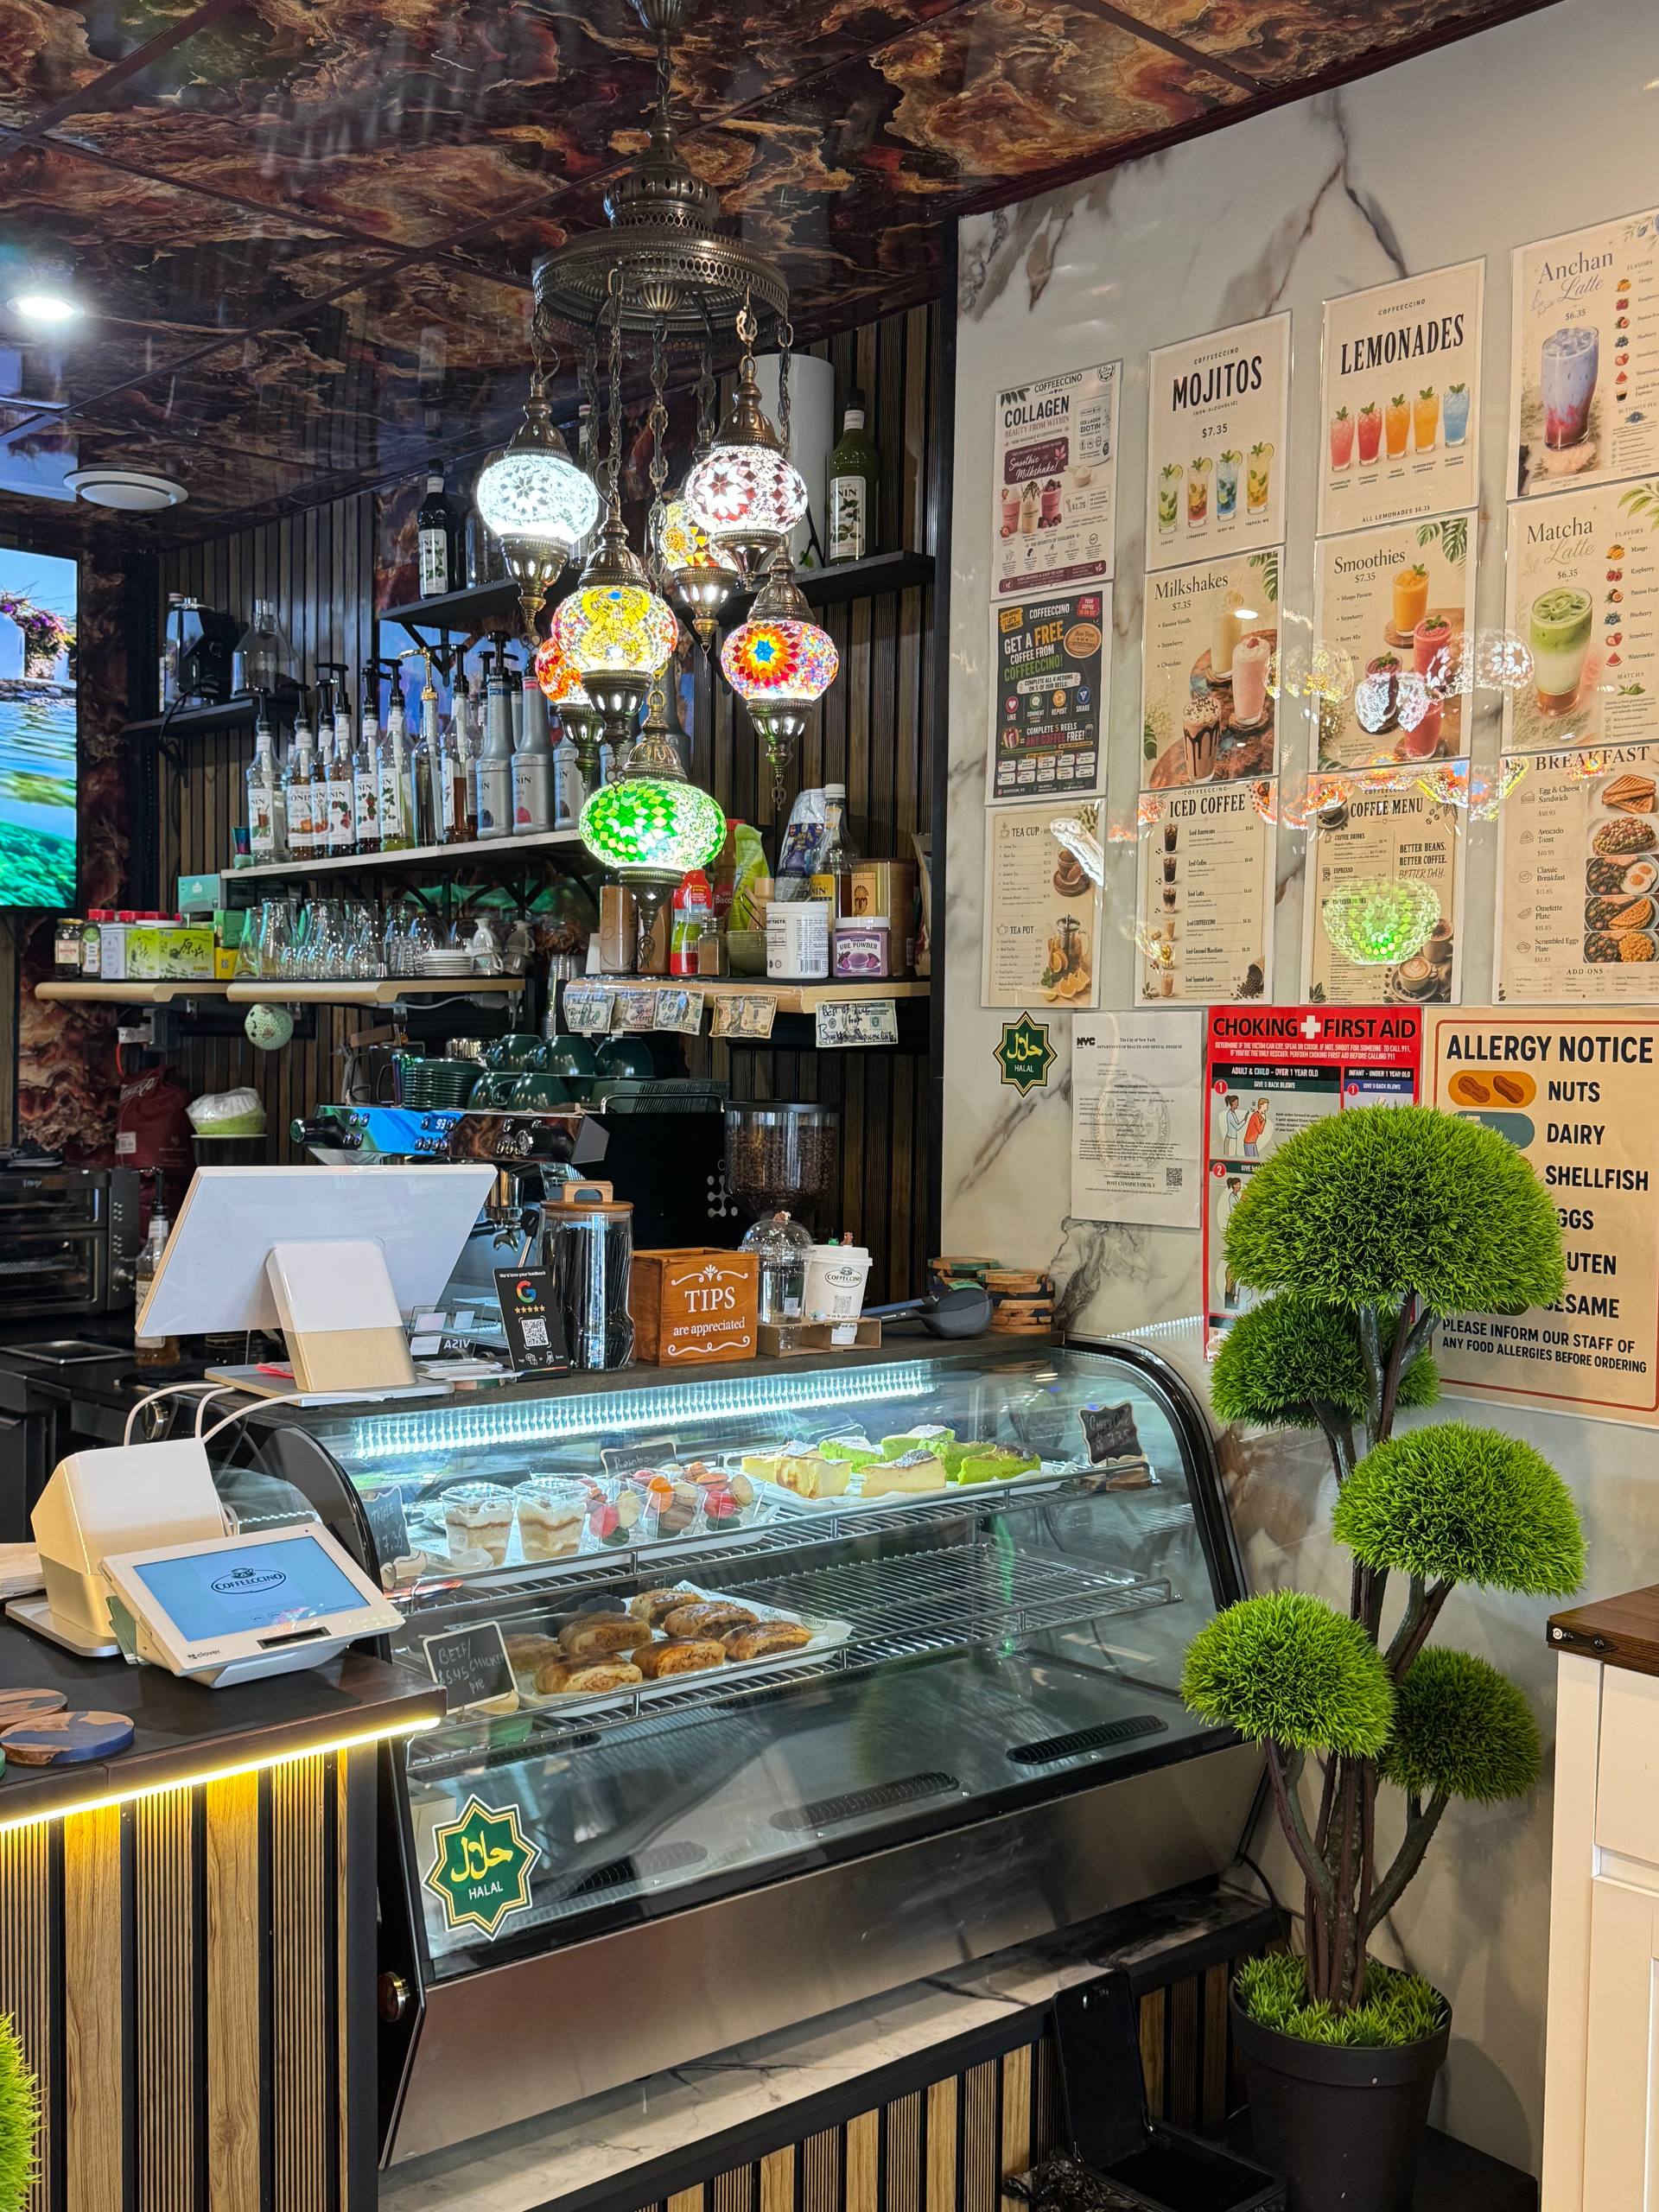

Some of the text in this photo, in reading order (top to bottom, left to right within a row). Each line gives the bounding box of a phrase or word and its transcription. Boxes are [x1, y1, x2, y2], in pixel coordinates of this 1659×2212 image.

[1538, 251, 1612, 285] Anchan
[1557, 274, 1604, 302] Latte
[1378, 298, 1426, 316] COFFEECCINO
[1565, 309, 1586, 321] $6.35
[1340, 313, 1465, 375] LEMONADES
[1193, 346, 1239, 365] COFFEECCINO
[1034, 372, 1083, 393] COFFEECCINO
[1173, 355, 1262, 411] MOJITOS
[1005, 395, 1070, 429] COLLAGEN
[1080, 423, 1101, 433] BIOTIN
[1202, 423, 1228, 439] $7.35
[1008, 454, 1040, 472] Smoothie
[1016, 462, 1058, 481] Milkshake!
[1362, 507, 1413, 523] ALL LEMONADES
[1527, 517, 1593, 544] Matcha
[1543, 537, 1595, 565] Latte
[1334, 549, 1406, 575] Smoothies
[1630, 566, 1655, 575] Raspberry
[1355, 572, 1376, 583] $7.35
[1557, 569, 1578, 580] $6.35
[1154, 572, 1229, 601] Milkshakes
[1029, 603, 1070, 620] COFFEECCINO
[1172, 601, 1192, 611] $7.35
[1630, 610, 1652, 619] Blueberry
[1004, 620, 1064, 655] GET A FREE
[1629, 631, 1653, 639] Strawberry
[1010, 644, 1054, 665] COFFEE FROM
[1004, 653, 1063, 682] COFFEECCINO!
[1618, 671, 1644, 680] MATCHA
[1007, 713, 1017, 721] LIKE
[1052, 707, 1067, 715] REPOST
[1076, 704, 1090, 713] SHARE
[1027, 722, 1077, 735] COMPLETE REELS
[1066, 730, 1084, 741] FREE!
[1535, 746, 1650, 771] BREAKFAST
[1184, 785, 1227, 796] COFFEECCINO
[1538, 795, 1568, 804] Sandwich
[1539, 785, 1581, 796] Egg Cheese
[1170, 794, 1246, 818] ICED COFFEE
[1351, 798, 1423, 817] COFFEE MENU
[1012, 826, 1039, 837] TEA CUP
[1538, 827, 1564, 836] Avocado
[1538, 836, 1554, 844] Toast
[1400, 842, 1446, 854] BETTER BEANS.
[1399, 855, 1447, 867] BETTER COFFEE.
[1399, 868, 1426, 880] BETTER
[1010, 925, 1034, 935] TEA POT
[853, 941, 878, 950] POWDER
[1566, 938, 1579, 946] Eggs
[1212, 1017, 1416, 1039] CHOKING FIRST AID
[1006, 1033, 1044, 1062] حلال
[1076, 1037, 1096, 1046] NYC
[1446, 1034, 1654, 1064] ALLERGY NOTICE
[1014, 1064, 1034, 1073] HALAL
[1275, 1068, 1288, 1077] OVER
[1308, 1069, 1319, 1077] OLD
[1548, 1081, 1600, 1103] NUTS
[1547, 1122, 1605, 1146] DAIRY
[1217, 1166, 1223, 1175] 2
[1545, 1165, 1649, 1192] SHELLFISH
[1556, 1207, 1594, 1230] GGS
[1567, 1251, 1617, 1275] UTEN
[684, 1286, 736, 1314] TIPS
[673, 1317, 746, 1337] are appreciated
[1442, 1318, 1636, 1354] PLEASE INFORM OUR STAFF OF
[1442, 1336, 1647, 1374] ANY FOOD ALLERGIES BEFORE ORDERING
[215, 1573, 283, 1591] COFFEECCINO
[198, 1649, 220, 1659] clover
[450, 1830, 514, 1883] حلال
[467, 1880, 504, 1900] HALAL
